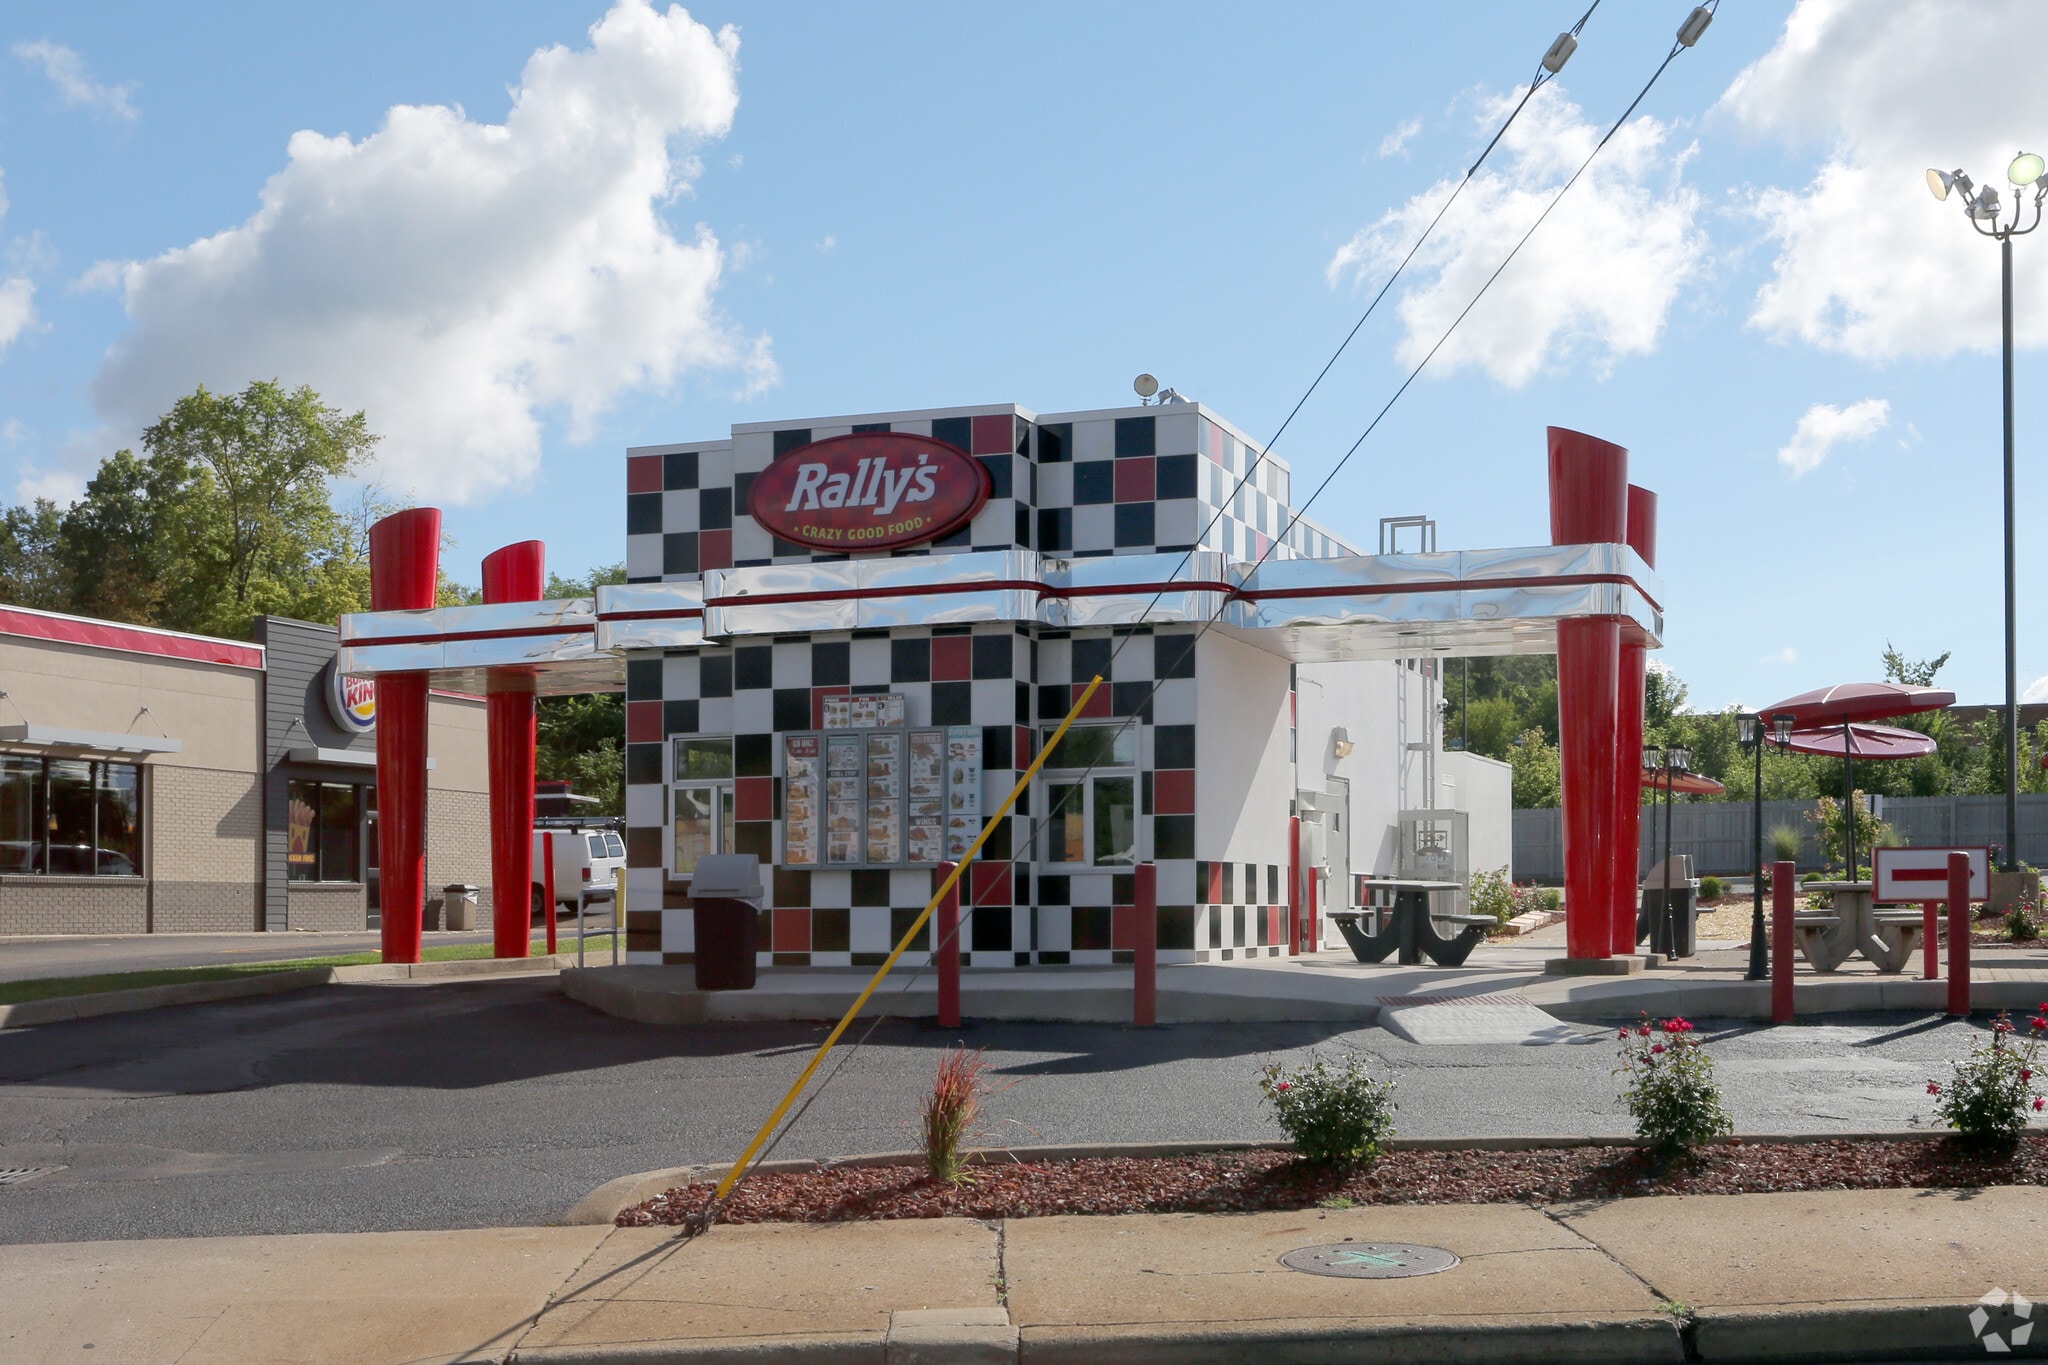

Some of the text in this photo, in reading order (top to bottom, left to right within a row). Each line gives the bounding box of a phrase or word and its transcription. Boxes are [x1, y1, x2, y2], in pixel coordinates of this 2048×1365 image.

[785, 454, 938, 515] Rally's
[802, 516, 923, 540] CRAZY GOOD FOOD
[347, 682, 374, 708] KIN
